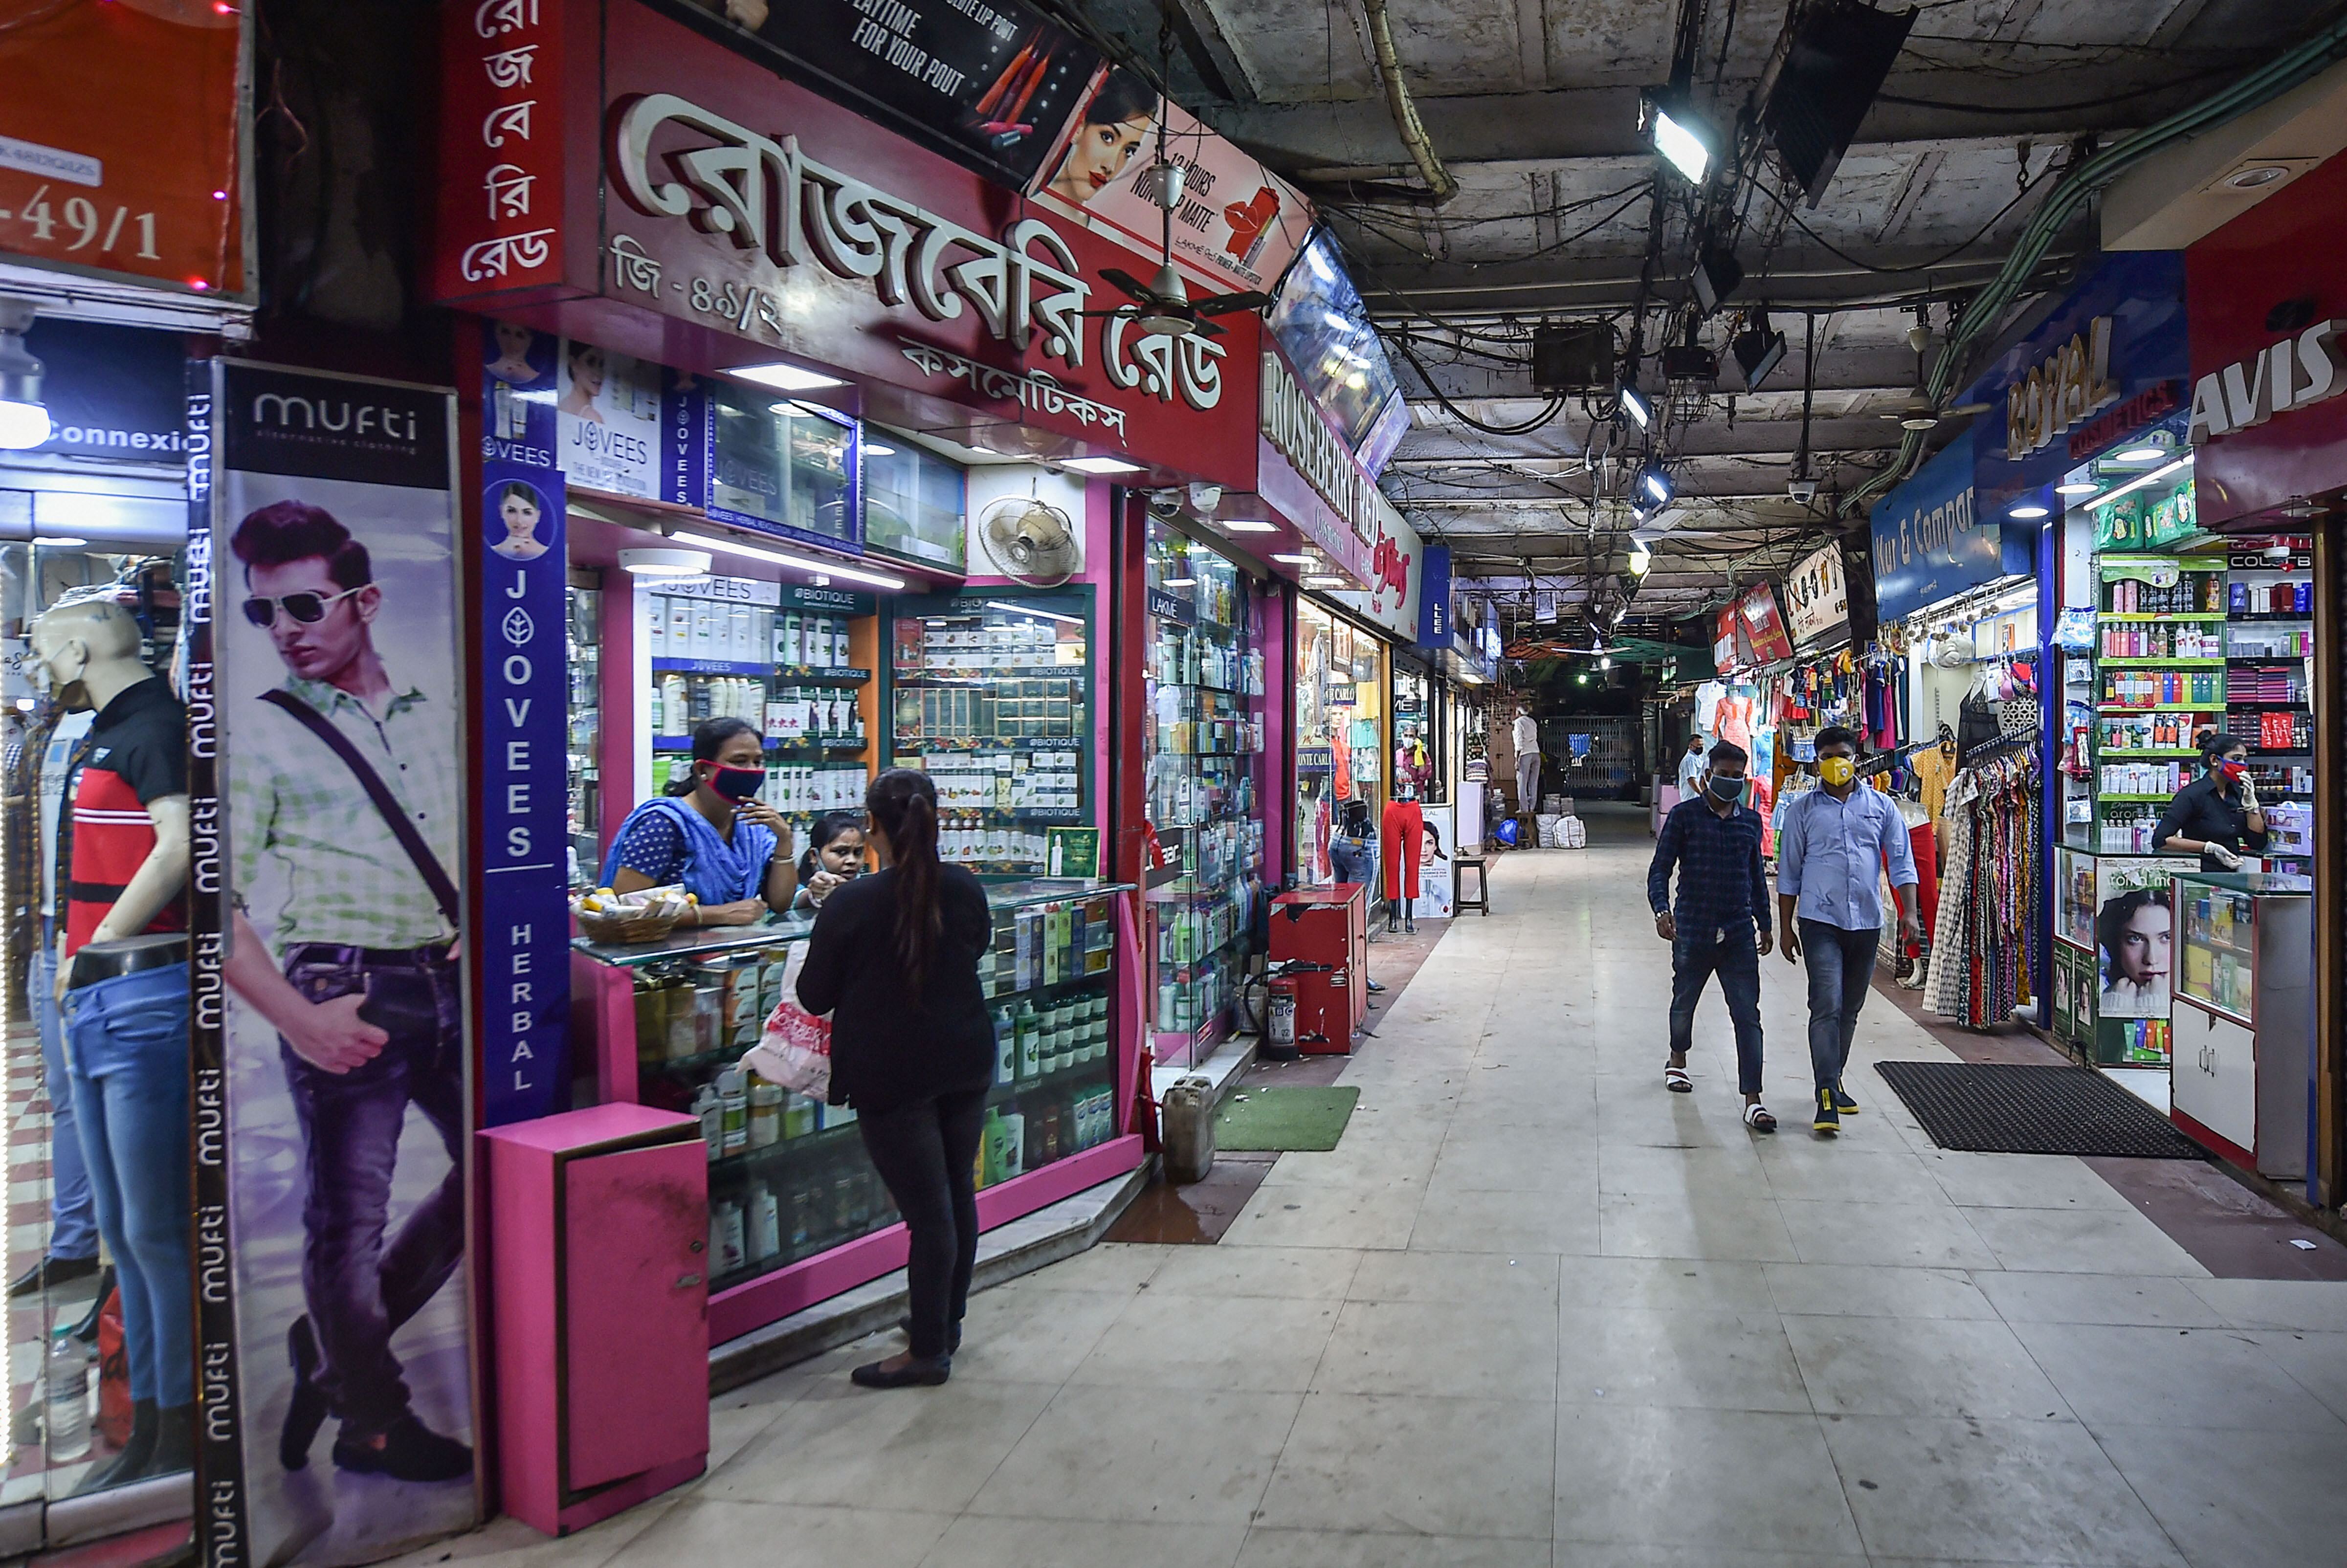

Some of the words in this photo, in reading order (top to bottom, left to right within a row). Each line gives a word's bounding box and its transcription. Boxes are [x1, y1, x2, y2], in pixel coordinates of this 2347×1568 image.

[843, 0, 922, 39] LAYTIME
[974, 4, 995, 25] LIP
[989, 14, 1018, 41] POUT
[851, 18, 886, 56] FOR
[885, 34, 929, 78] YOUR
[922, 58, 966, 97] POUT
[461, 229, 556, 281] রেড
[610, 93, 1092, 368] রোজবেরি
[609, 234, 662, 299] জি
[2008, 316, 2121, 462] ROYAL
[2184, 319, 2340, 445] AVIS
[254, 393, 415, 440] mufti
[1266, 351, 1355, 523] ROSEBERRY
[1358, 474, 1379, 548] RED
[1900, 518, 1911, 565] &
[2231, 556, 2311, 567] COLB
[803, 588, 855, 604] BIOTIQUE
[1152, 596, 1177, 618] LAKMÉ
[1038, 667, 1080, 676] BIOTIQUE
[1334, 688, 1355, 701] CARLO
[189, 663, 217, 758] mufti
[1037, 738, 1080, 747] BIOTIQUE
[193, 797, 220, 893] mufti
[1038, 808, 1081, 817] BIOTIQUE
[196, 932, 222, 1030] mufti
[510, 923, 534, 1091] HERBAL
[197, 1069, 221, 1166] mufti
[199, 1205, 227, 1304] mufti
[205, 1343, 232, 1442] mufti
